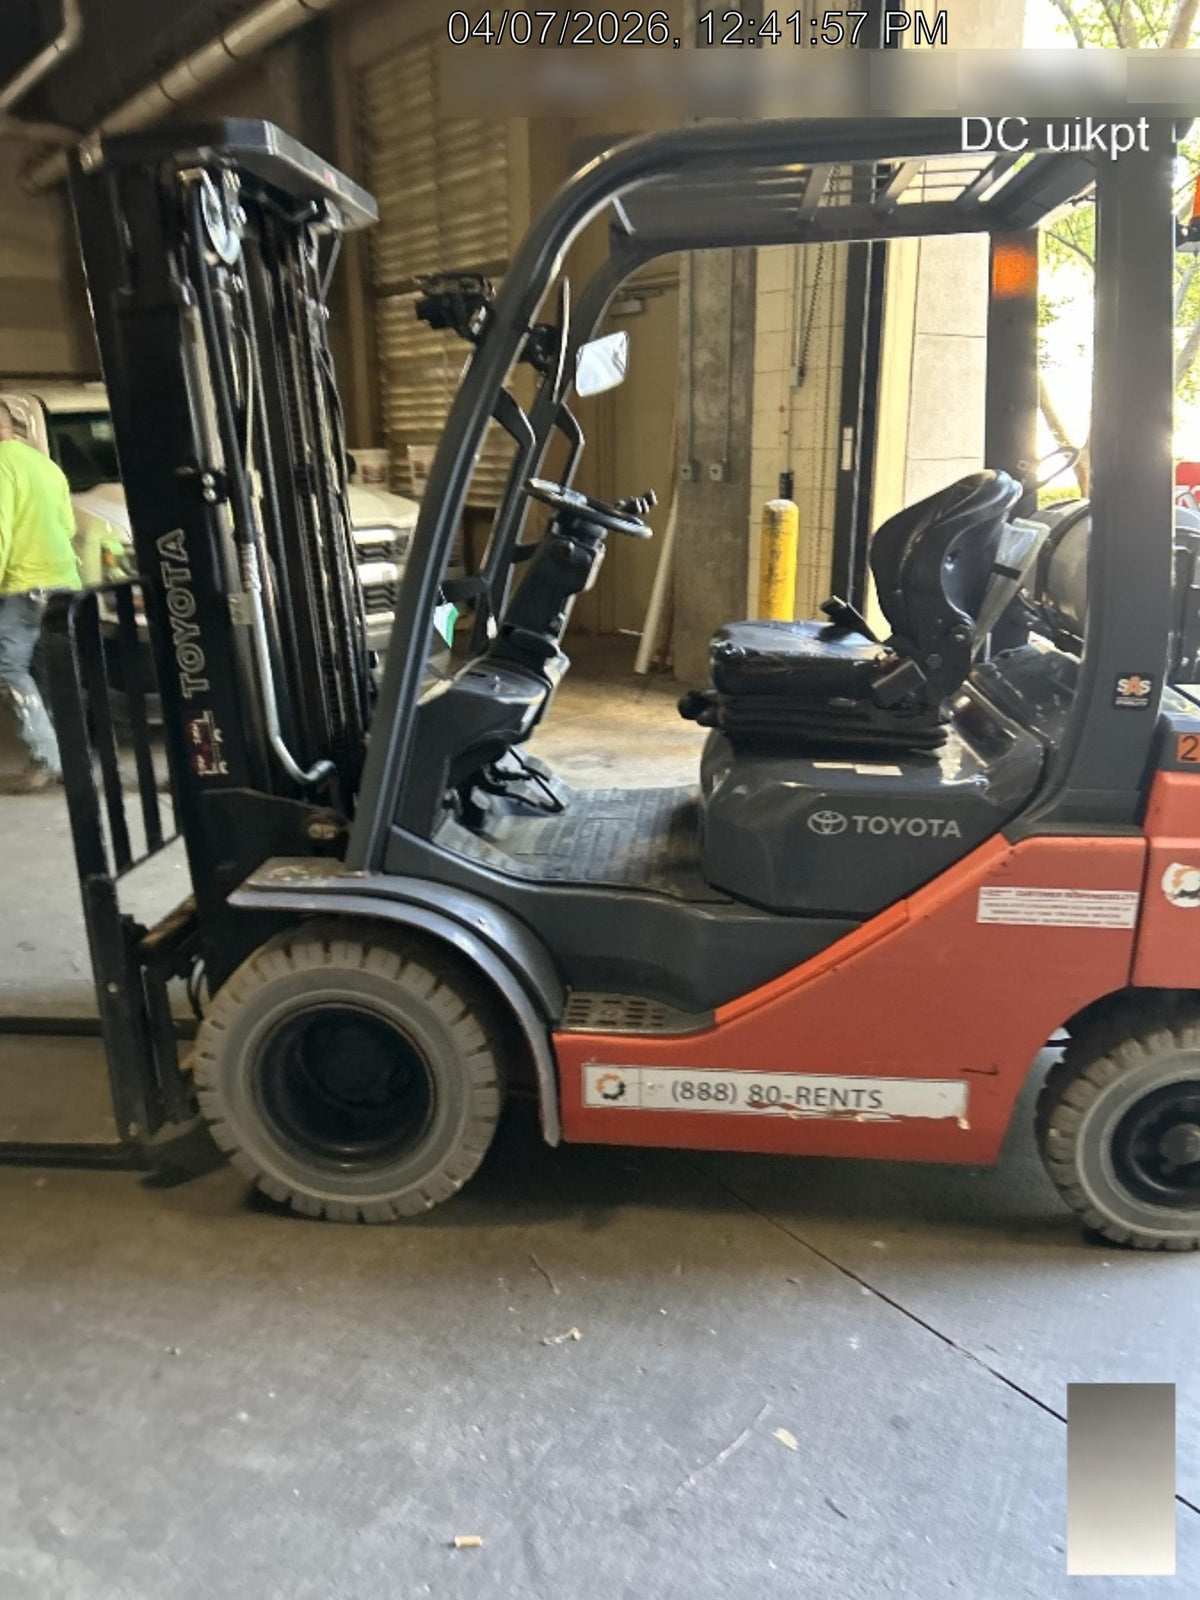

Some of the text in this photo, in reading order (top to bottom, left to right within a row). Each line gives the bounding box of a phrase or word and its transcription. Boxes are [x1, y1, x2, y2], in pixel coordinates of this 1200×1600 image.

[156, 527, 210, 699] TOYOTA
[1116, 675, 1152, 697] SAS
[852, 814, 963, 839] TOYOTA
[671, 1080, 884, 1109] (888) 80-RENTS
